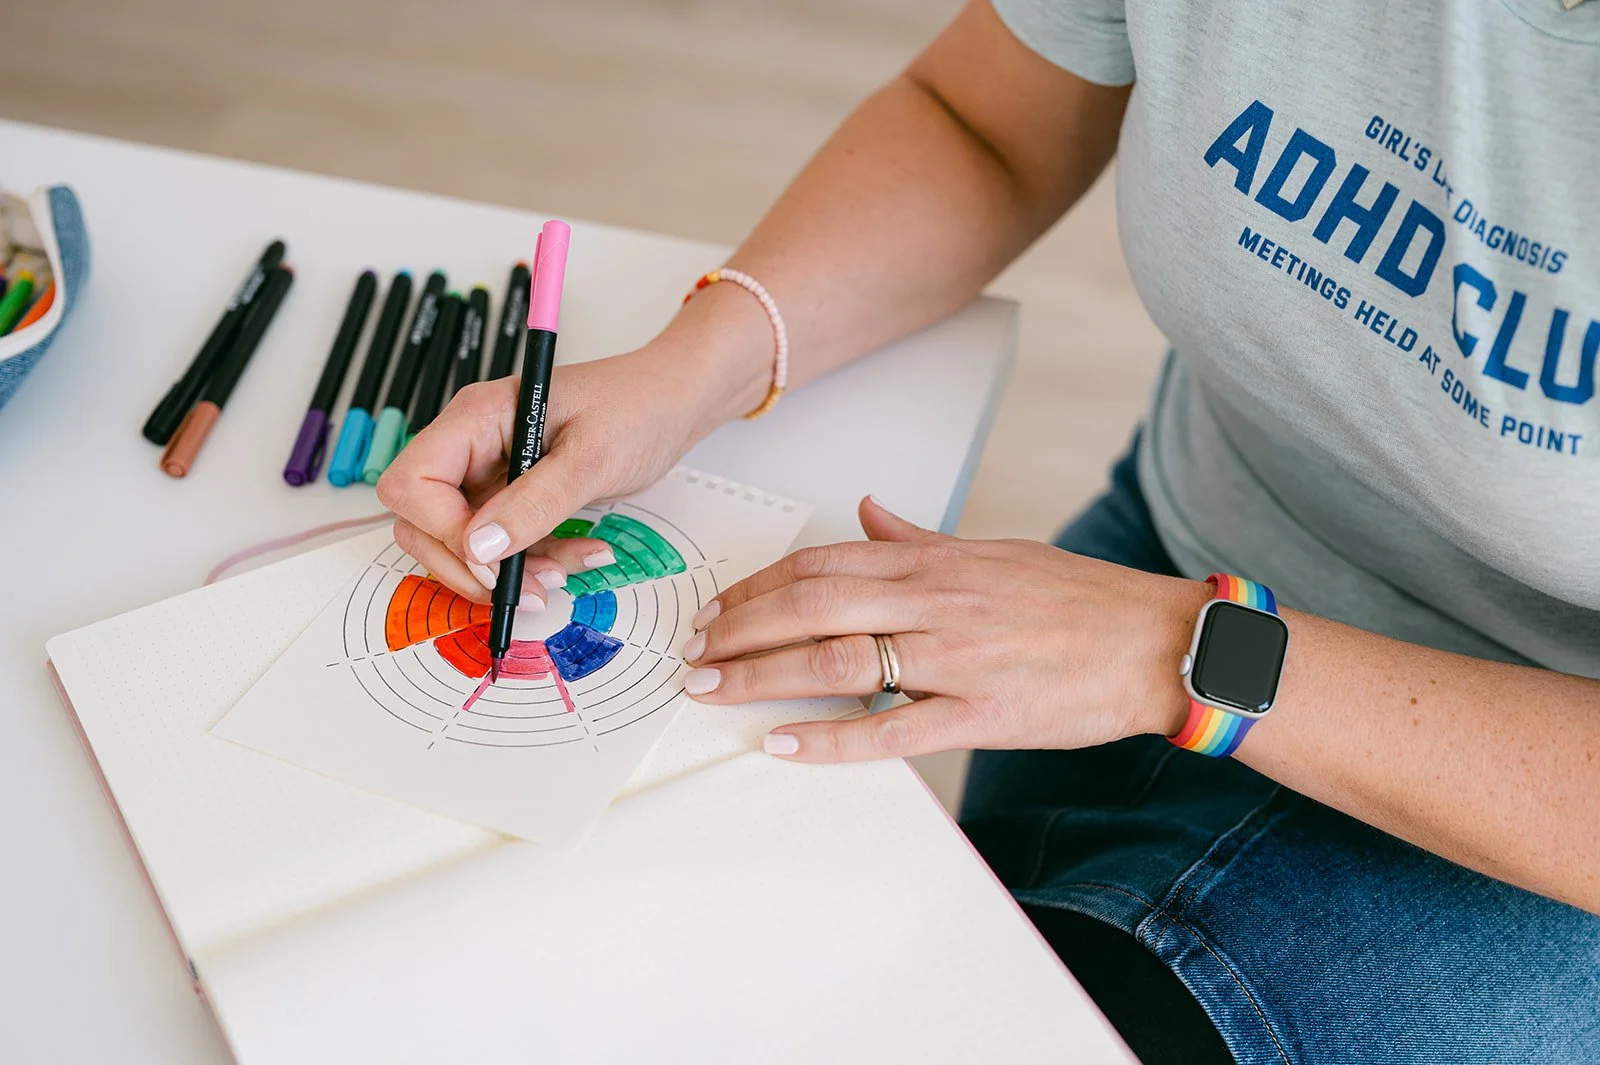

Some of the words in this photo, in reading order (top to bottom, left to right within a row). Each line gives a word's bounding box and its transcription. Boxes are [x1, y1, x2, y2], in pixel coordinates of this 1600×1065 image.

[1203, 99, 1446, 298] ADHD
[1452, 263, 1600, 405] CLU
[1365, 115, 1432, 171] GIRL'S
[1453, 199, 1569, 274] DIAGNOSIS
[522, 383, 543, 458] FABER-CASTELL
[1238, 226, 1352, 310] MEETINGS
[1354, 300, 1419, 353] HELD
[1418, 345, 1441, 376] AT
[1440, 368, 1491, 429] SOME
[1501, 415, 1583, 456] POINT
